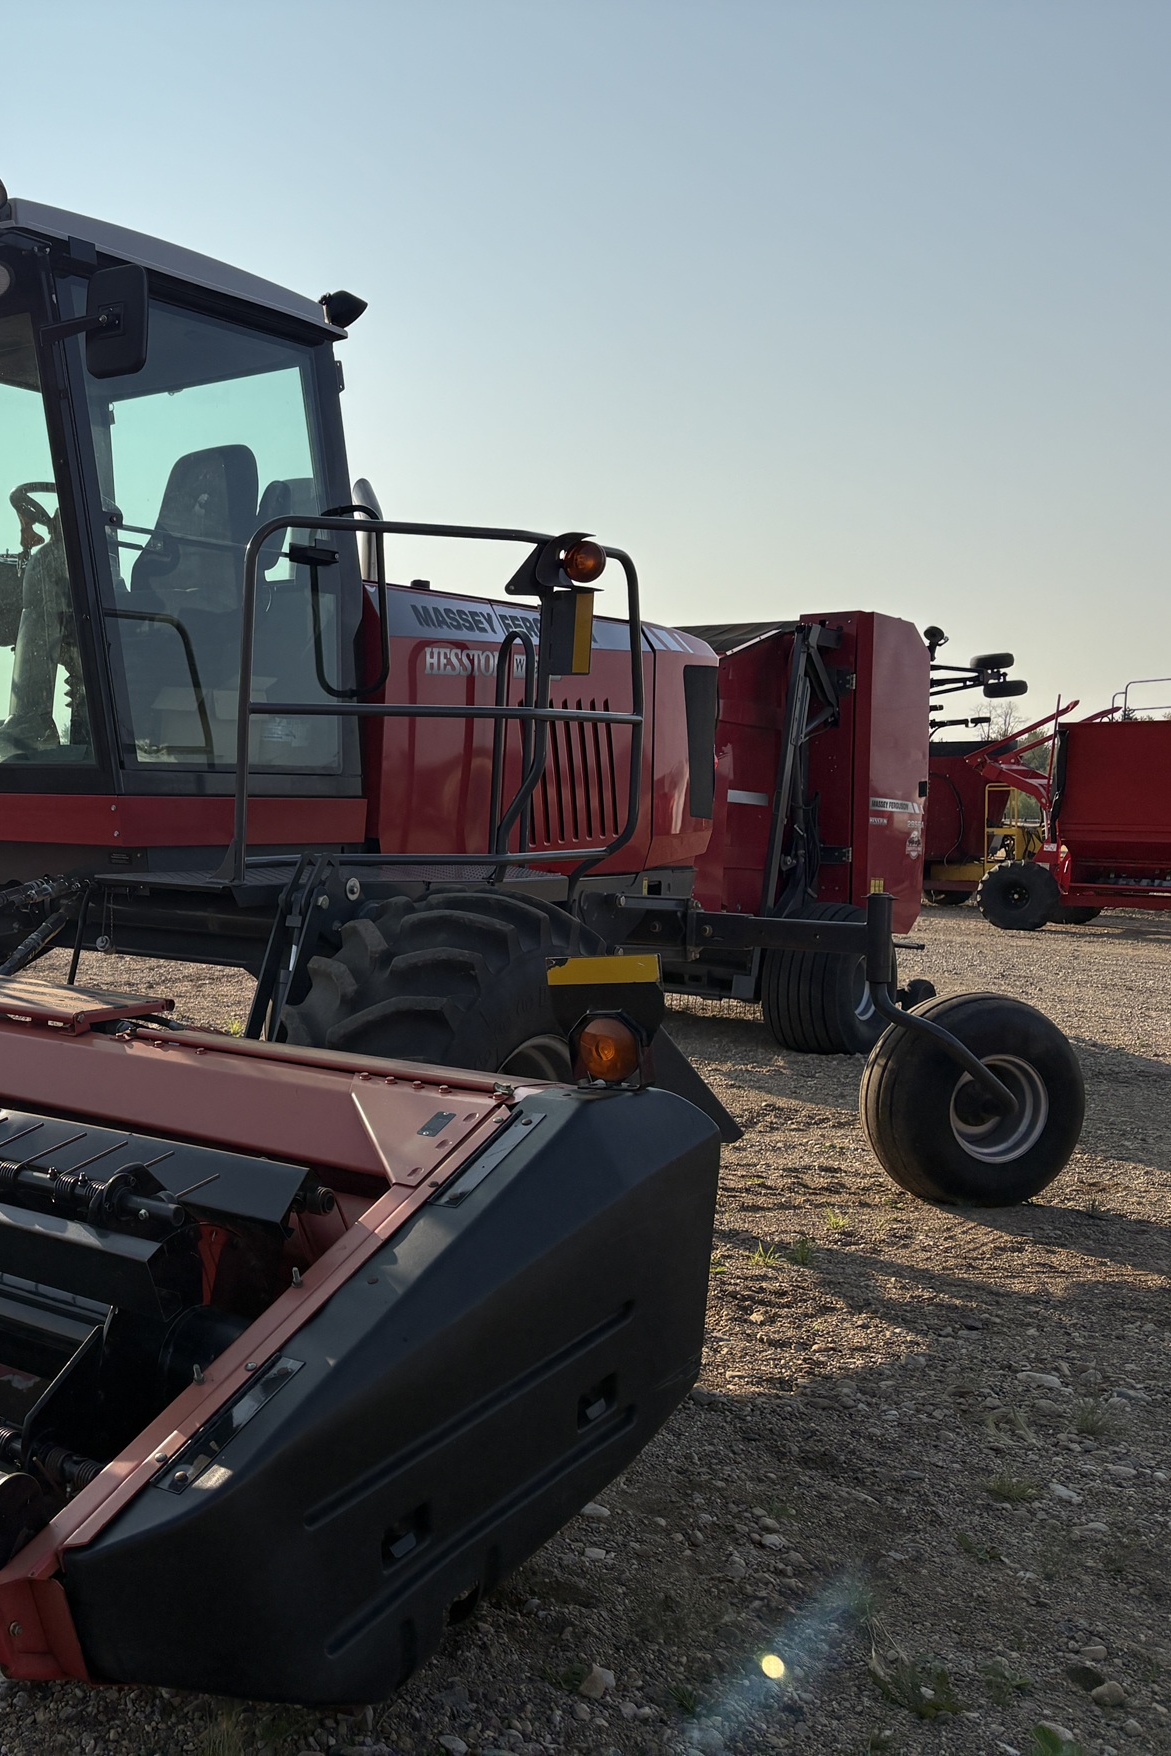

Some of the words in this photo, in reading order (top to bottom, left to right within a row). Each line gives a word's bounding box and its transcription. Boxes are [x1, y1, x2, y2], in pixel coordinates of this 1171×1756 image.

[410, 604, 497, 634] MASSEY
[424, 647, 499, 676] HESSTO
[871, 800, 888, 809] MASSEY
